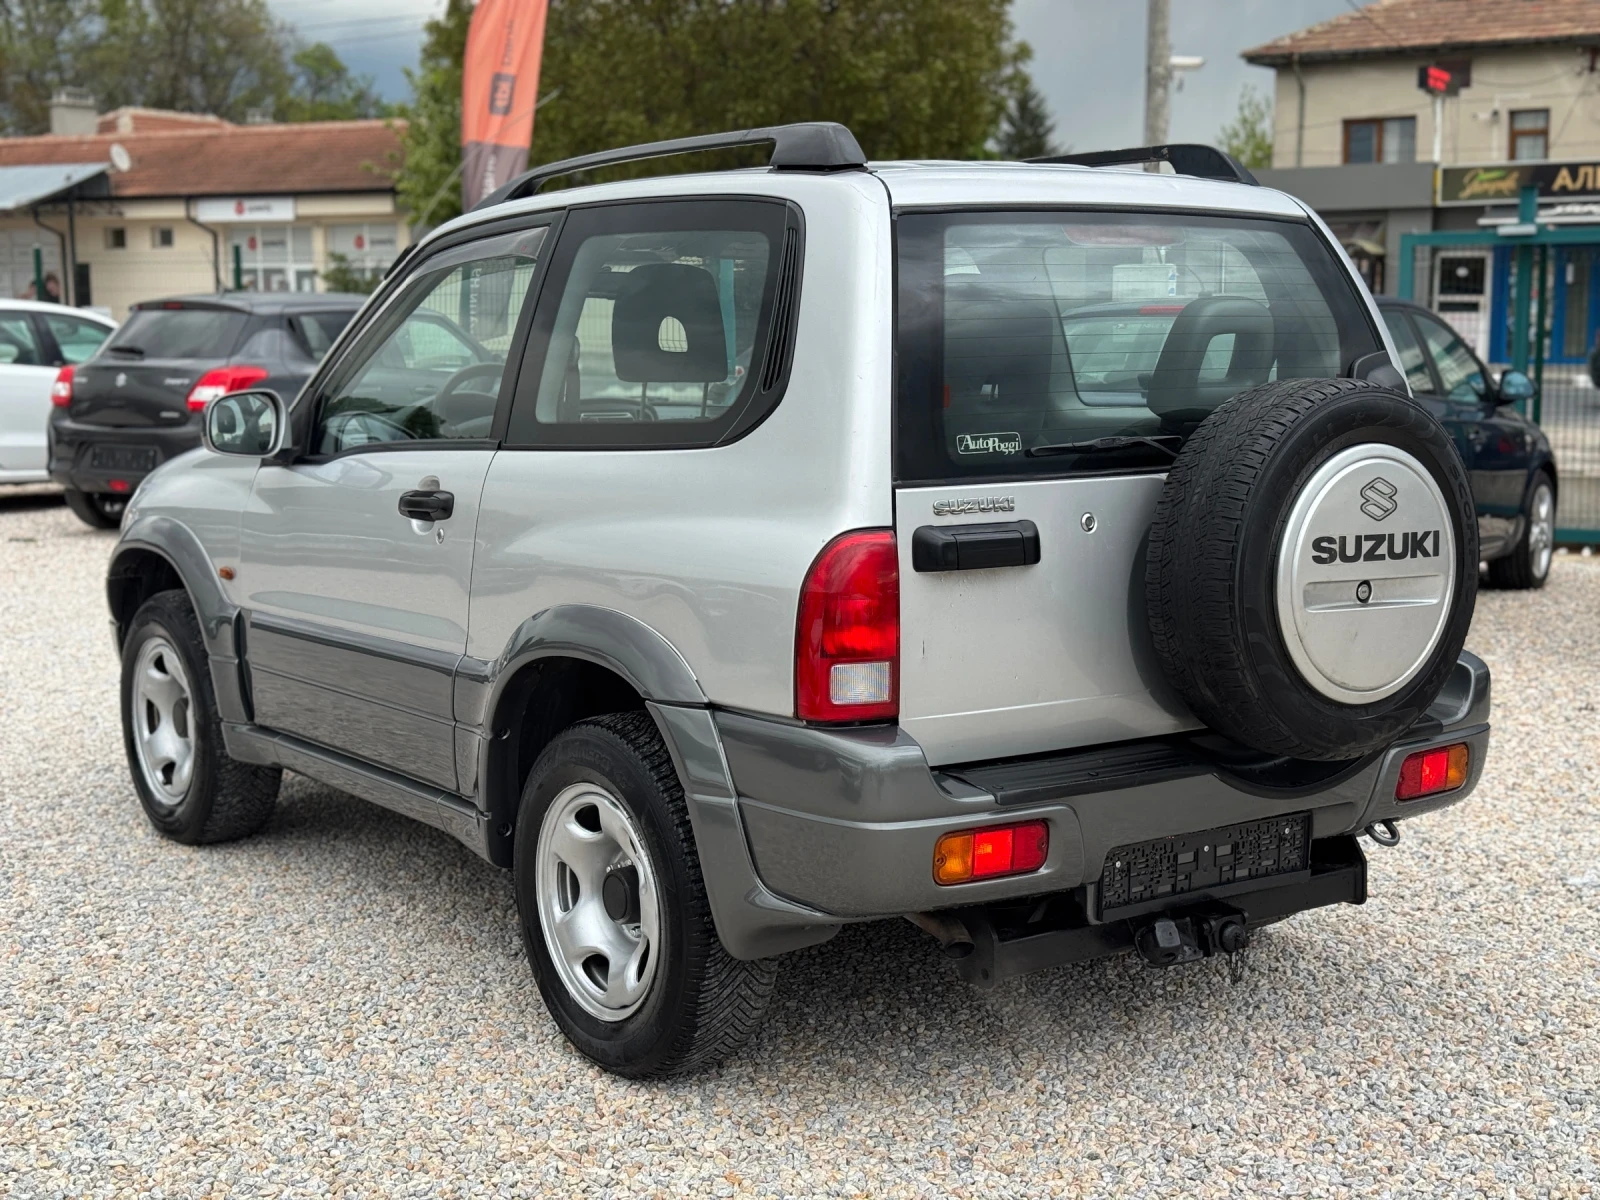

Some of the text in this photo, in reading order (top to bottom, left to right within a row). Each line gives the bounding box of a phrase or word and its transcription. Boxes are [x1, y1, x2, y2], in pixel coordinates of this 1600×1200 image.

[961, 434, 1019, 455] AutoPoggi
[933, 496, 1015, 516] SUZUKI
[1311, 530, 1440, 565] SUZUKI
